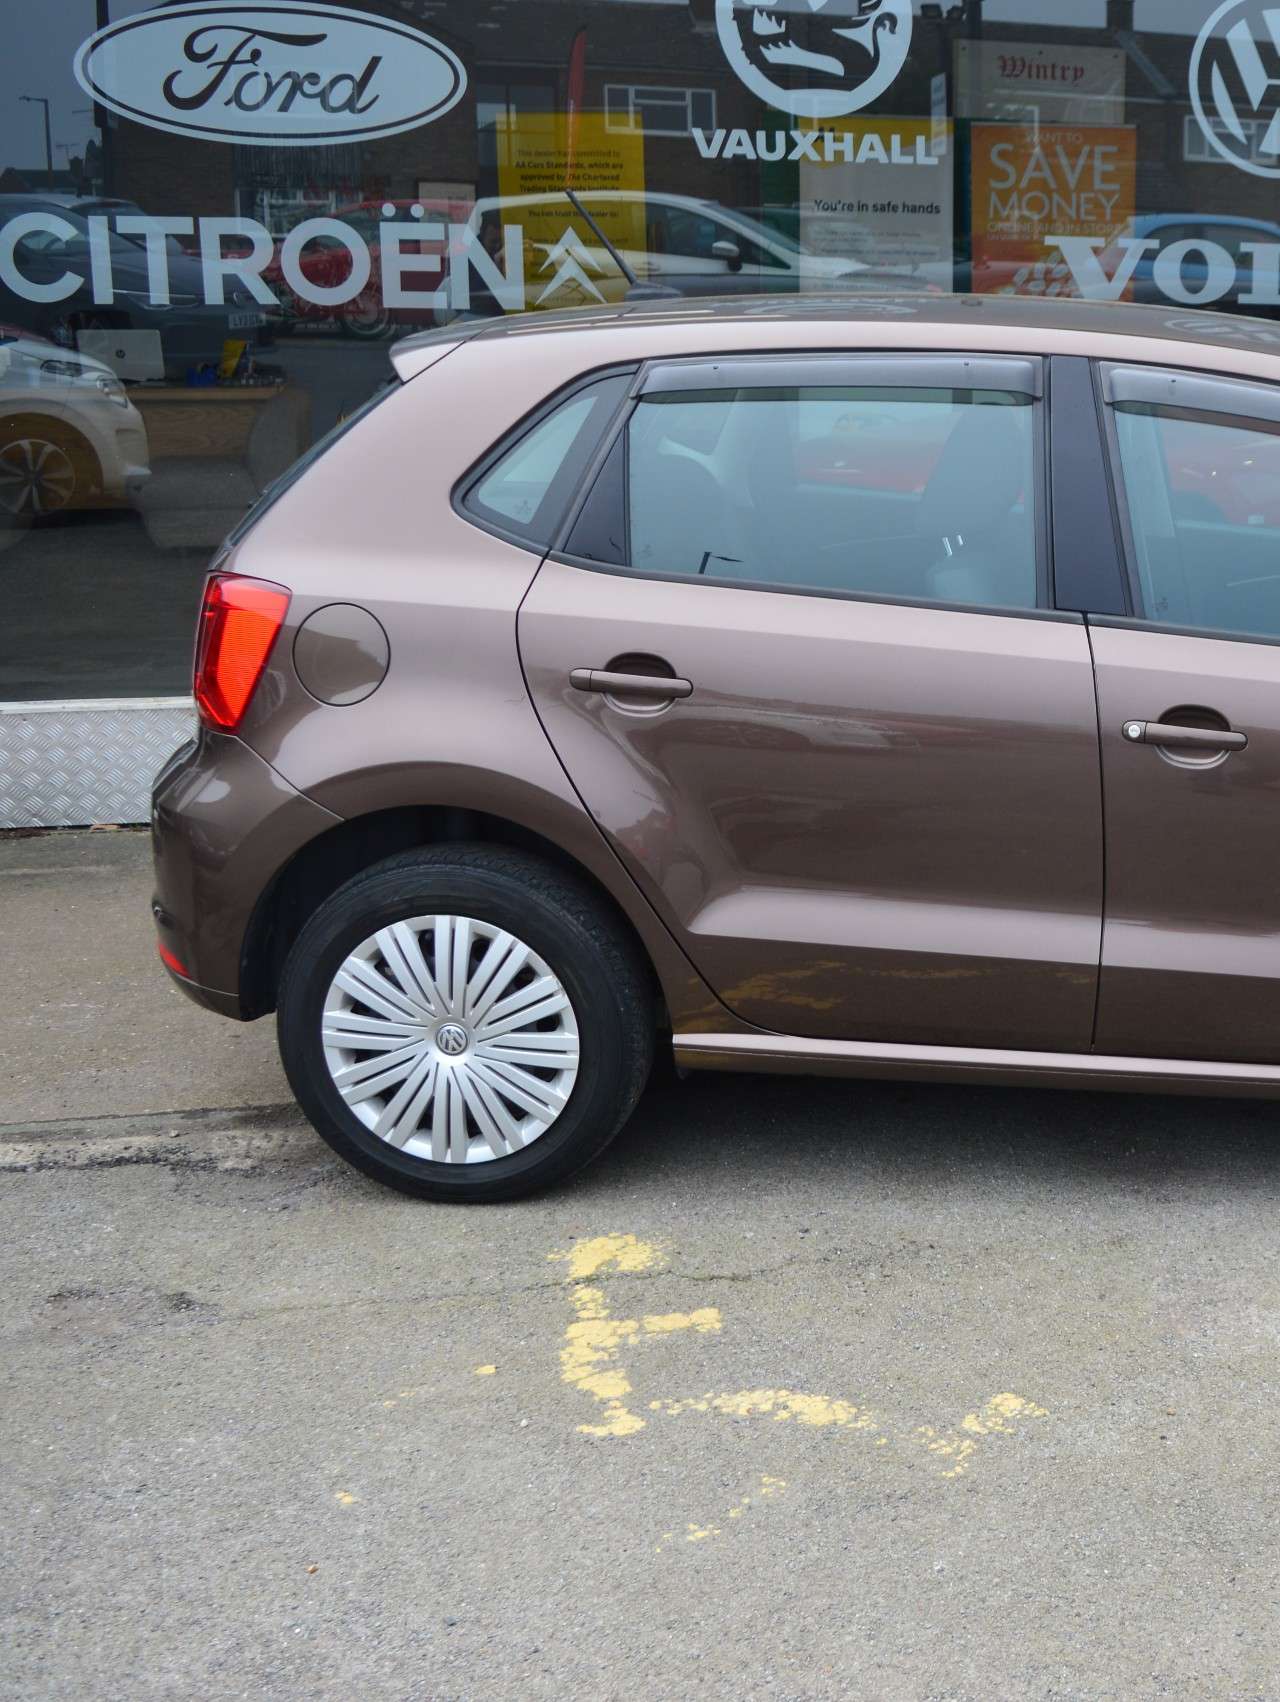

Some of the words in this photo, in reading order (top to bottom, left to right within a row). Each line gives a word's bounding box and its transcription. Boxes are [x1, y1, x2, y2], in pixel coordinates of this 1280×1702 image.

[161, 25, 383, 115] Ford
[997, 55, 1085, 86] Wintry
[692, 128, 939, 165] VAUXHALL
[989, 143, 1121, 190] SAVE
[814, 200, 855, 213] You're
[857, 200, 869, 212] in
[872, 201, 899, 213] safe
[902, 202, 941, 214] hands
[989, 192, 1121, 222] MONEY
[0, 203, 525, 310] CITROËN
